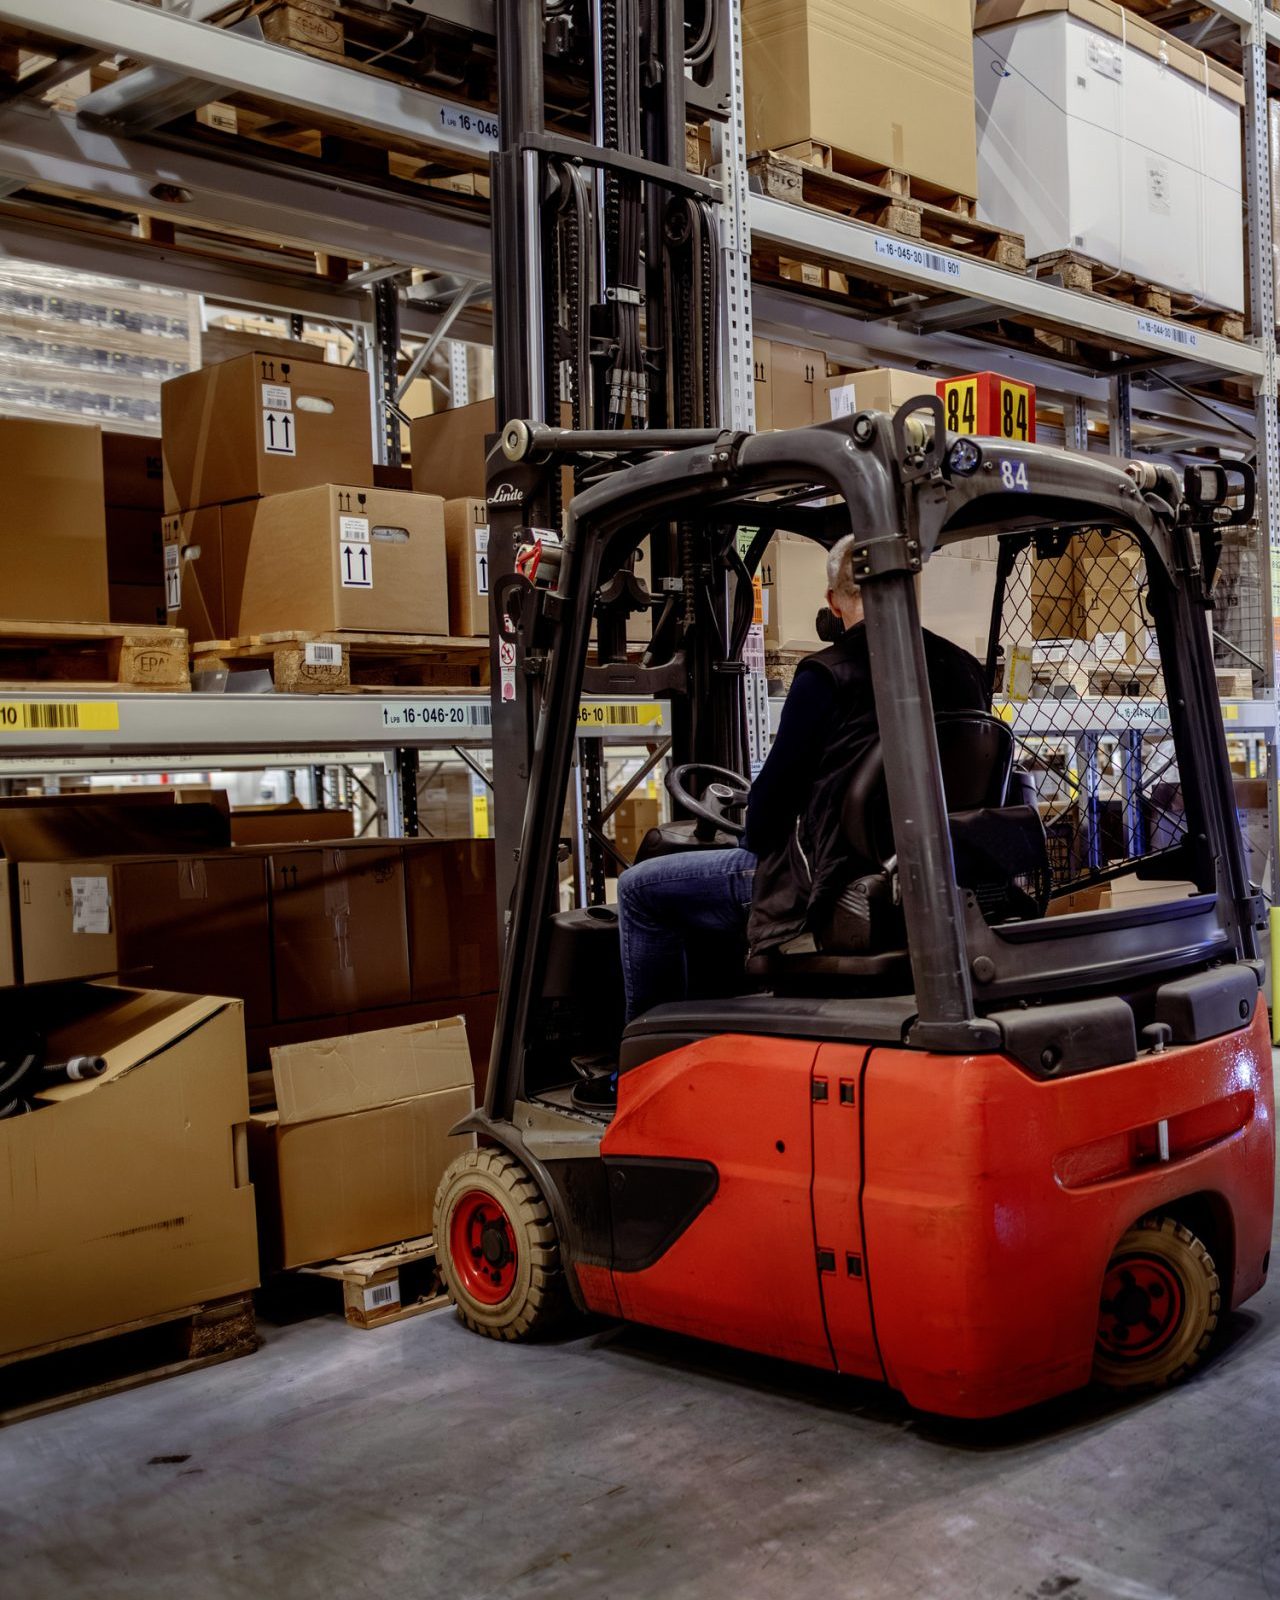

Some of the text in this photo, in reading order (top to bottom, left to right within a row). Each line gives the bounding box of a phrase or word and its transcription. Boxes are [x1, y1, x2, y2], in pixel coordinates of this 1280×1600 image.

[886, 243, 923, 264] 16-045-30
[947, 261, 960, 275] 901
[947, 386, 975, 434] 84
[1003, 388, 1027, 442] 84
[1001, 461, 1029, 491] 84
[487, 483, 524, 504] Linde
[390, 708, 464, 724] LPB 16-046-20
